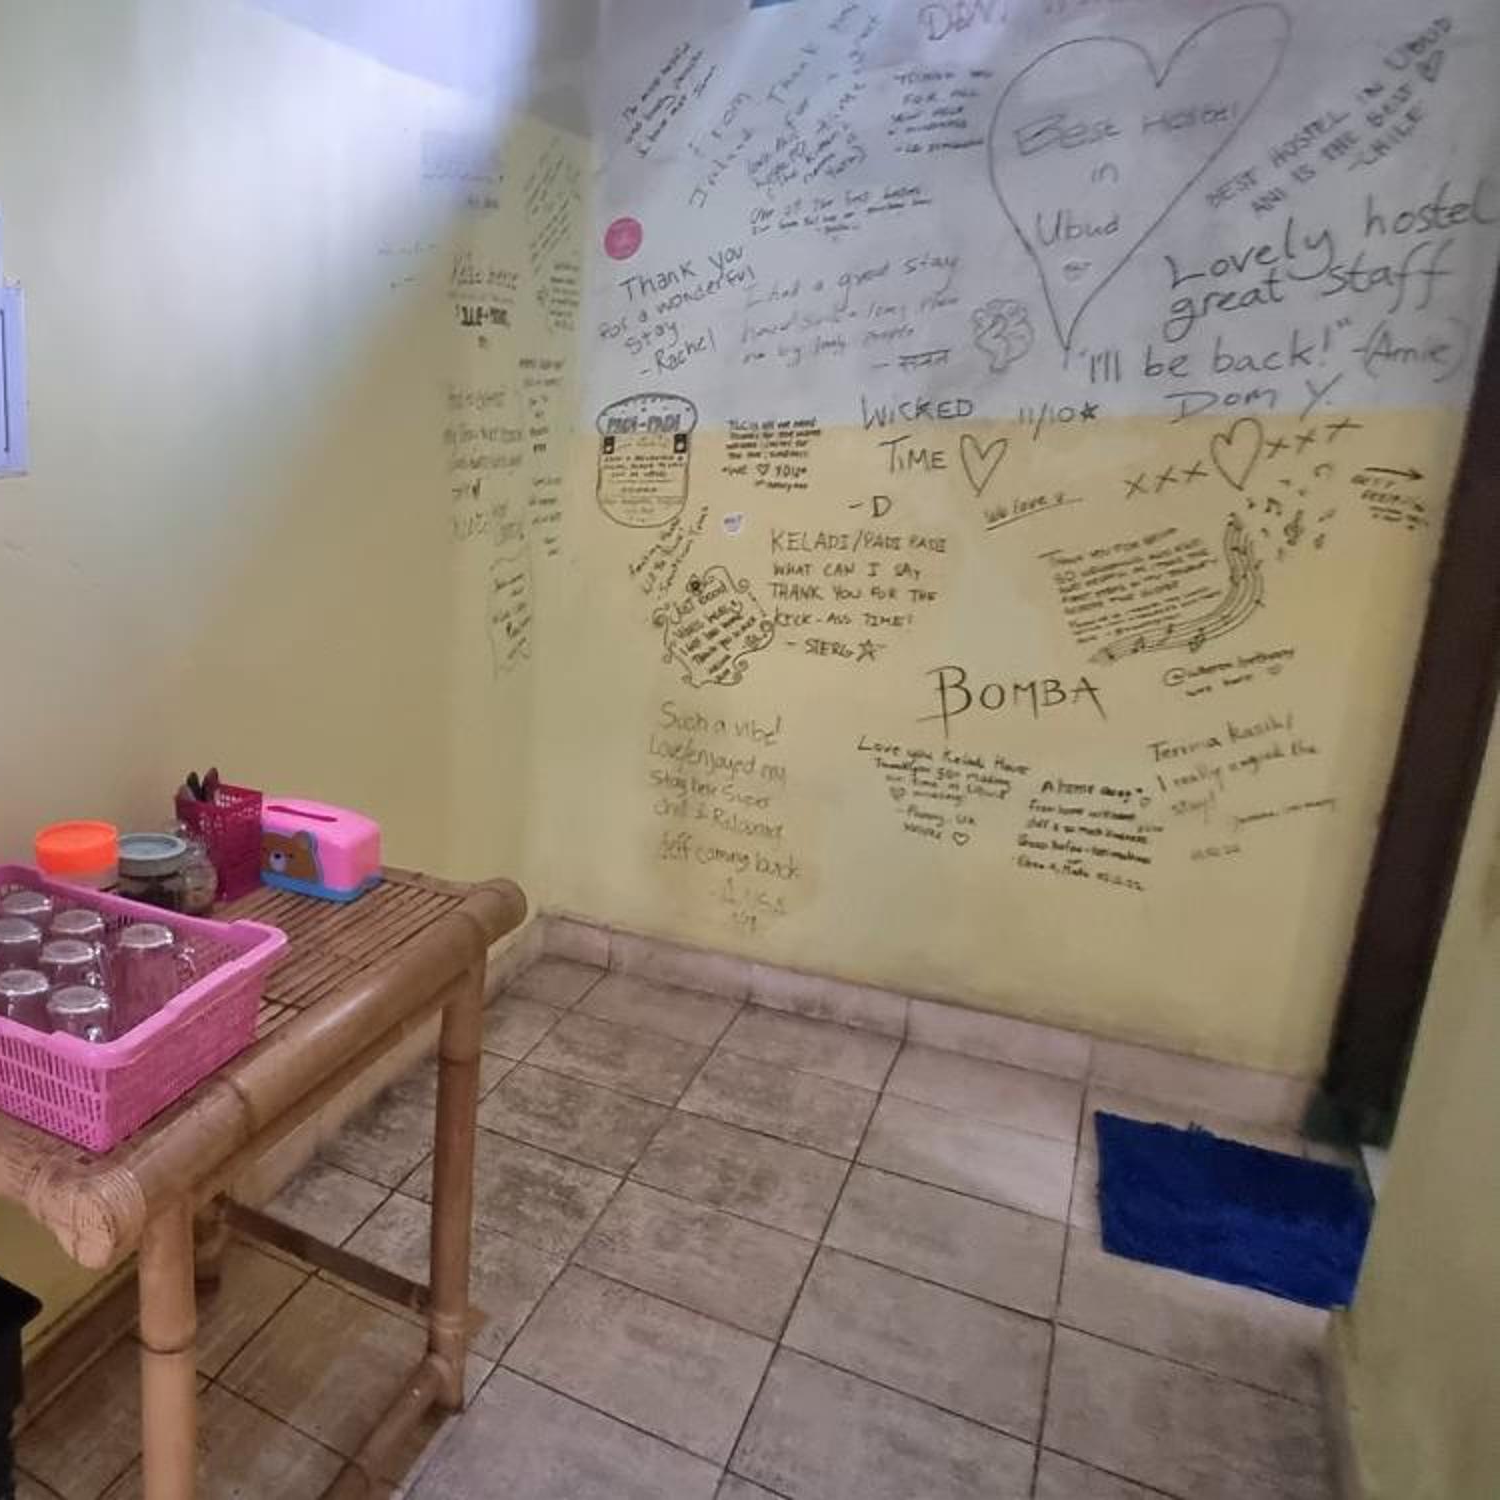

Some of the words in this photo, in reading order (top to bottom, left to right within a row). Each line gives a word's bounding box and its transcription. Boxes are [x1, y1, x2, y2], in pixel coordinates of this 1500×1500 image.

[1092, 163, 1119, 183] in
[1036, 209, 1120, 247] Ubud
[1164, 218, 1334, 290] Lovely
[1365, 181, 1499, 238] hostel
[619, 259, 700, 301] Thank
[1162, 267, 1285, 344] great
[1322, 239, 1456, 315] staff
[1144, 344, 1190, 379] be
[823, 563, 856, 577] CAN
[915, 665, 1108, 739] BOMBA
